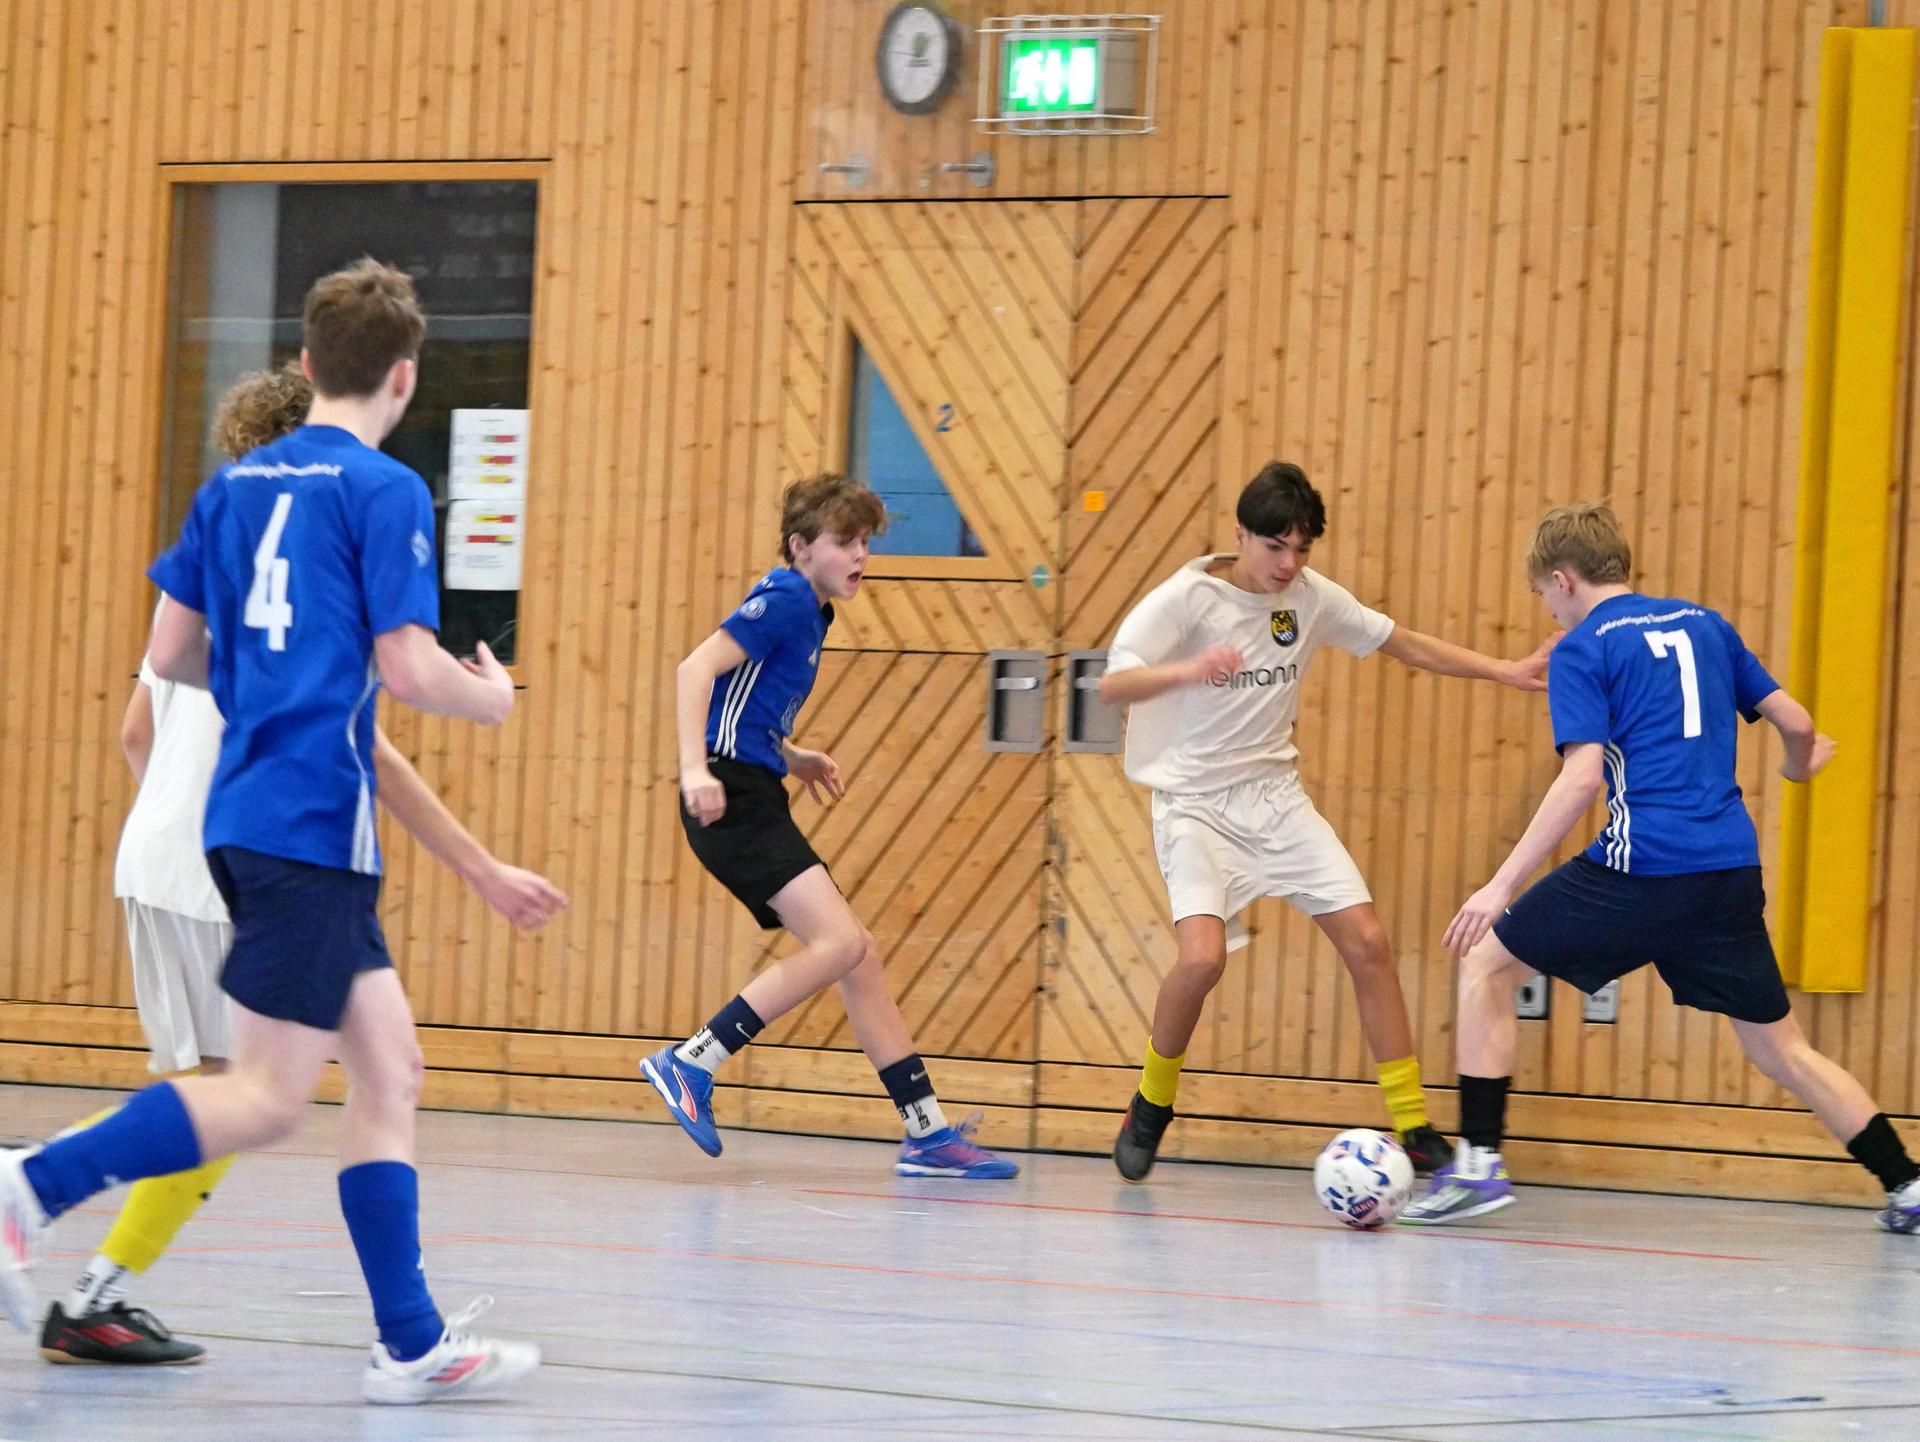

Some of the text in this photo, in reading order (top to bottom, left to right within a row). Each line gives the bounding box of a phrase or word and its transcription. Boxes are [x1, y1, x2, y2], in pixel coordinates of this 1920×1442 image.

[935, 402, 953, 432] 2
[244, 493, 293, 651] 4
[1643, 628, 1702, 738] 7
